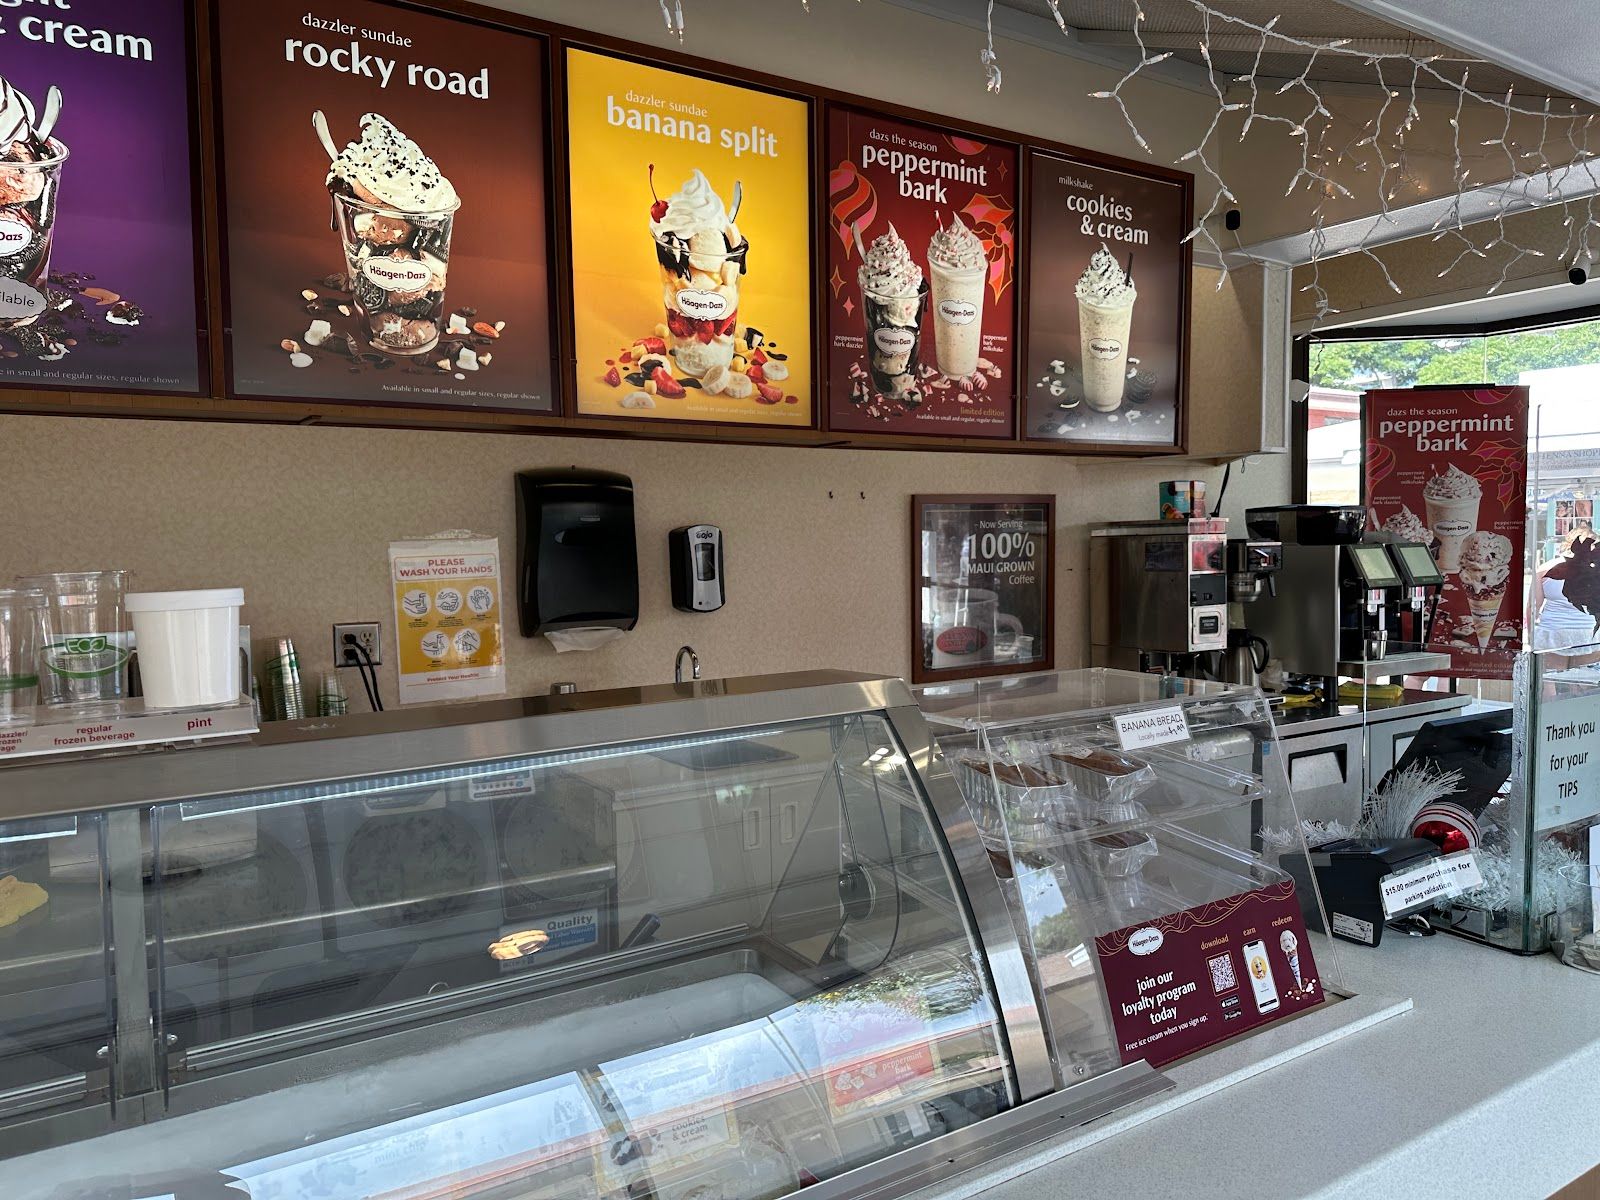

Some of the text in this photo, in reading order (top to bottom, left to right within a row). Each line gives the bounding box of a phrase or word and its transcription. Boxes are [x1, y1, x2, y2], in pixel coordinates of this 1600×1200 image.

[19, 16, 153, 61] cream
[302, 13, 412, 47] dazzler sundae
[285, 38, 489, 100] rocky road
[626, 90, 708, 118] dazzler sundae
[607, 96, 778, 158] banana split
[869, 128, 938, 152] dazs the season
[862, 144, 987, 186] peppermint
[899, 171, 947, 204] bark
[1058, 176, 1094, 190] milkshake
[1066, 194, 1133, 221] cookies
[1080, 214, 1149, 245] & cream
[0, 291, 35, 307] lable
[18, 369, 41, 377] small
[43, 370, 60, 378] and
[62, 372, 93, 380] regular
[121, 375, 150, 383] regular
[153, 376, 180, 384] shown
[382, 384, 411, 392] Available
[422, 386, 439, 394] small
[454, 388, 477, 397] regular
[497, 391, 518, 399] regular
[960, 407, 1005, 416] limited edition
[1387, 407, 1458, 416] dazs the season
[1380, 413, 1514, 438] peppermint
[1416, 432, 1468, 452] bark
[979, 519, 1023, 530] Now Serving
[968, 532, 1035, 559] 100%
[400, 565, 493, 577] WASH YOUR HANDS
[428, 558, 465, 566] PLEASE
[967, 561, 1035, 574] MAUI GROWN
[1009, 574, 1035, 585] Coffee
[77, 725, 113, 735] regular
[187, 717, 212, 730] pint
[1121, 718, 1156, 732] BANANA
[1546, 721, 1595, 742] Thank you
[54, 731, 135, 746] frozen beverage
[1550, 751, 1589, 772] for your
[1558, 780, 1578, 799] TIPS
[1385, 862, 1471, 896] $15.00 minimum purchase for
[1404, 881, 1452, 904] parking validation
[547, 915, 593, 930] Quality
[1271, 915, 1293, 927] redeem
[1243, 927, 1257, 936] earn
[1201, 934, 1230, 950] download
[1136, 971, 1174, 995] join our
[1122, 982, 1196, 1016] loyalty program
[1150, 1006, 1177, 1025] today
[1125, 1043, 1138, 1051] Free
[1138, 1037, 1147, 1046] ice
[1147, 1031, 1163, 1043] cream
[1163, 1025, 1178, 1037] when
[1178, 1022, 1189, 1032] you
[1188, 1017, 1200, 1027] sign
